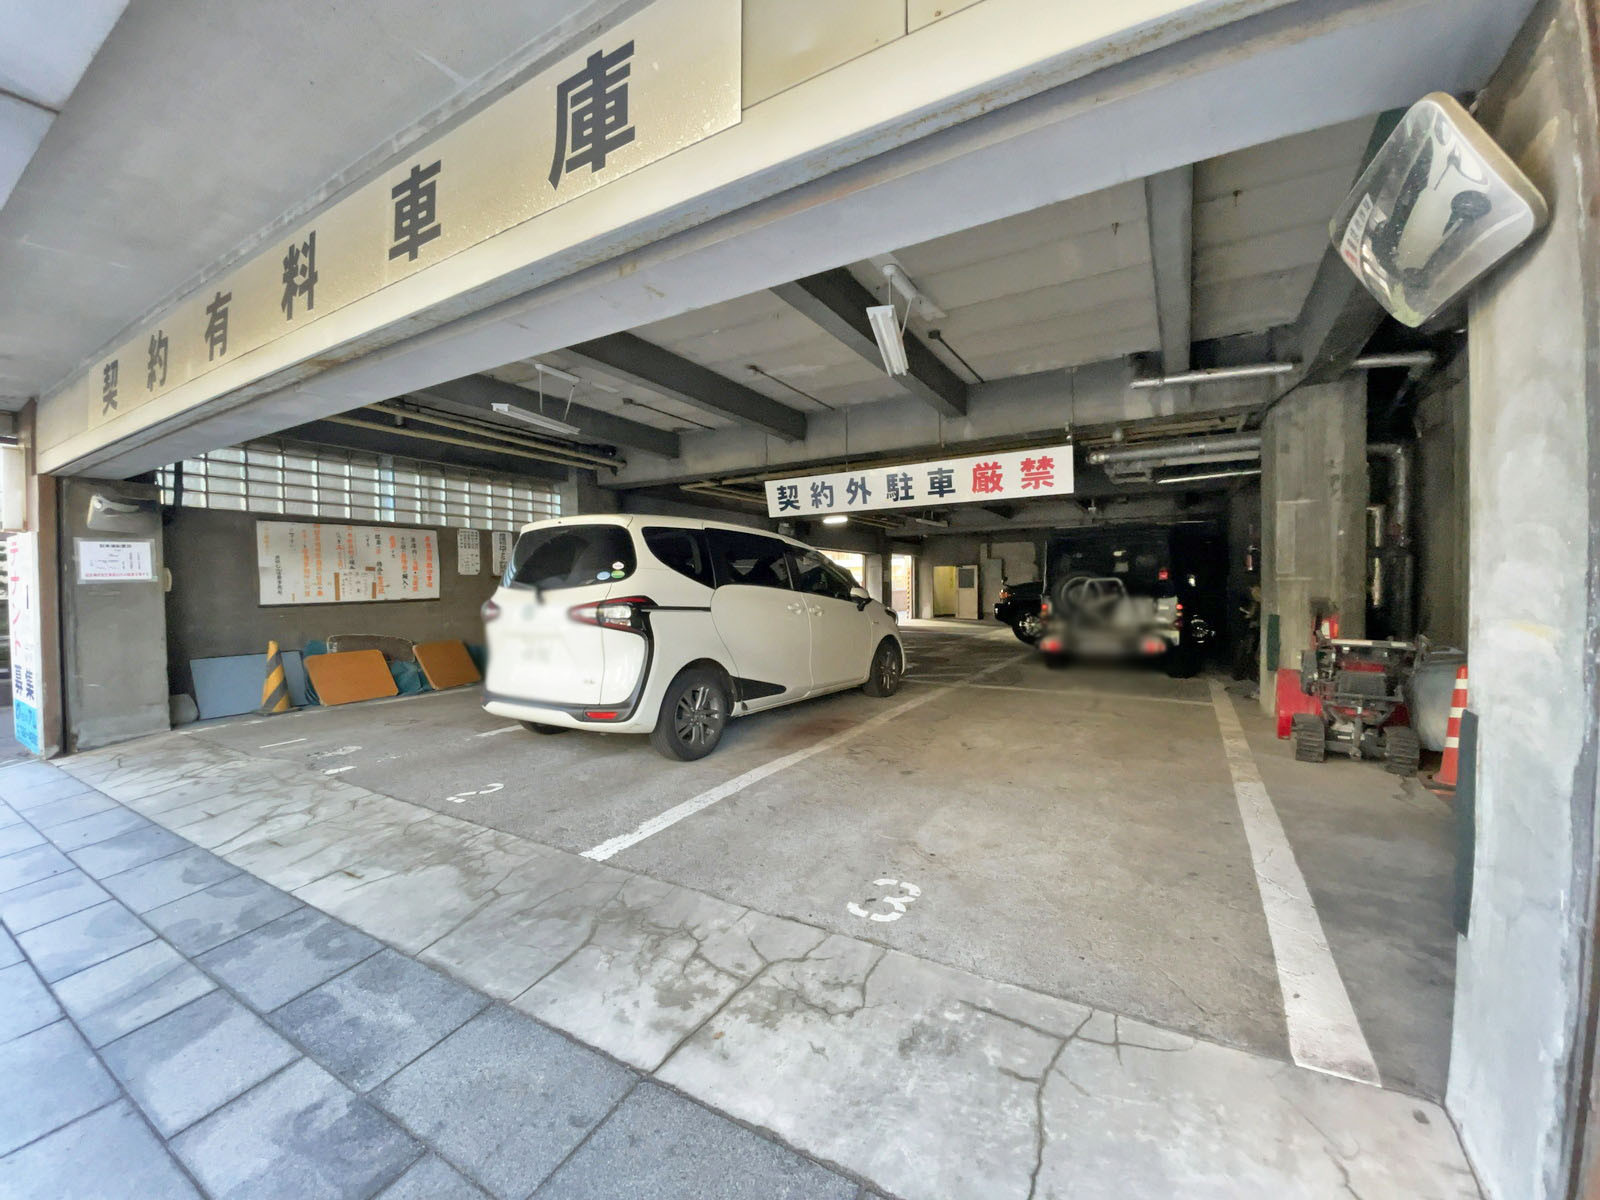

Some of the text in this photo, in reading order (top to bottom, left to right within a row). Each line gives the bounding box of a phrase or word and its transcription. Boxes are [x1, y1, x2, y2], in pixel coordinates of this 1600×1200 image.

[102, 39, 635, 416] 契約有料車庫
[776, 455, 1055, 512] 契約外駐車厳禁
[846, 878, 922, 922] 3
